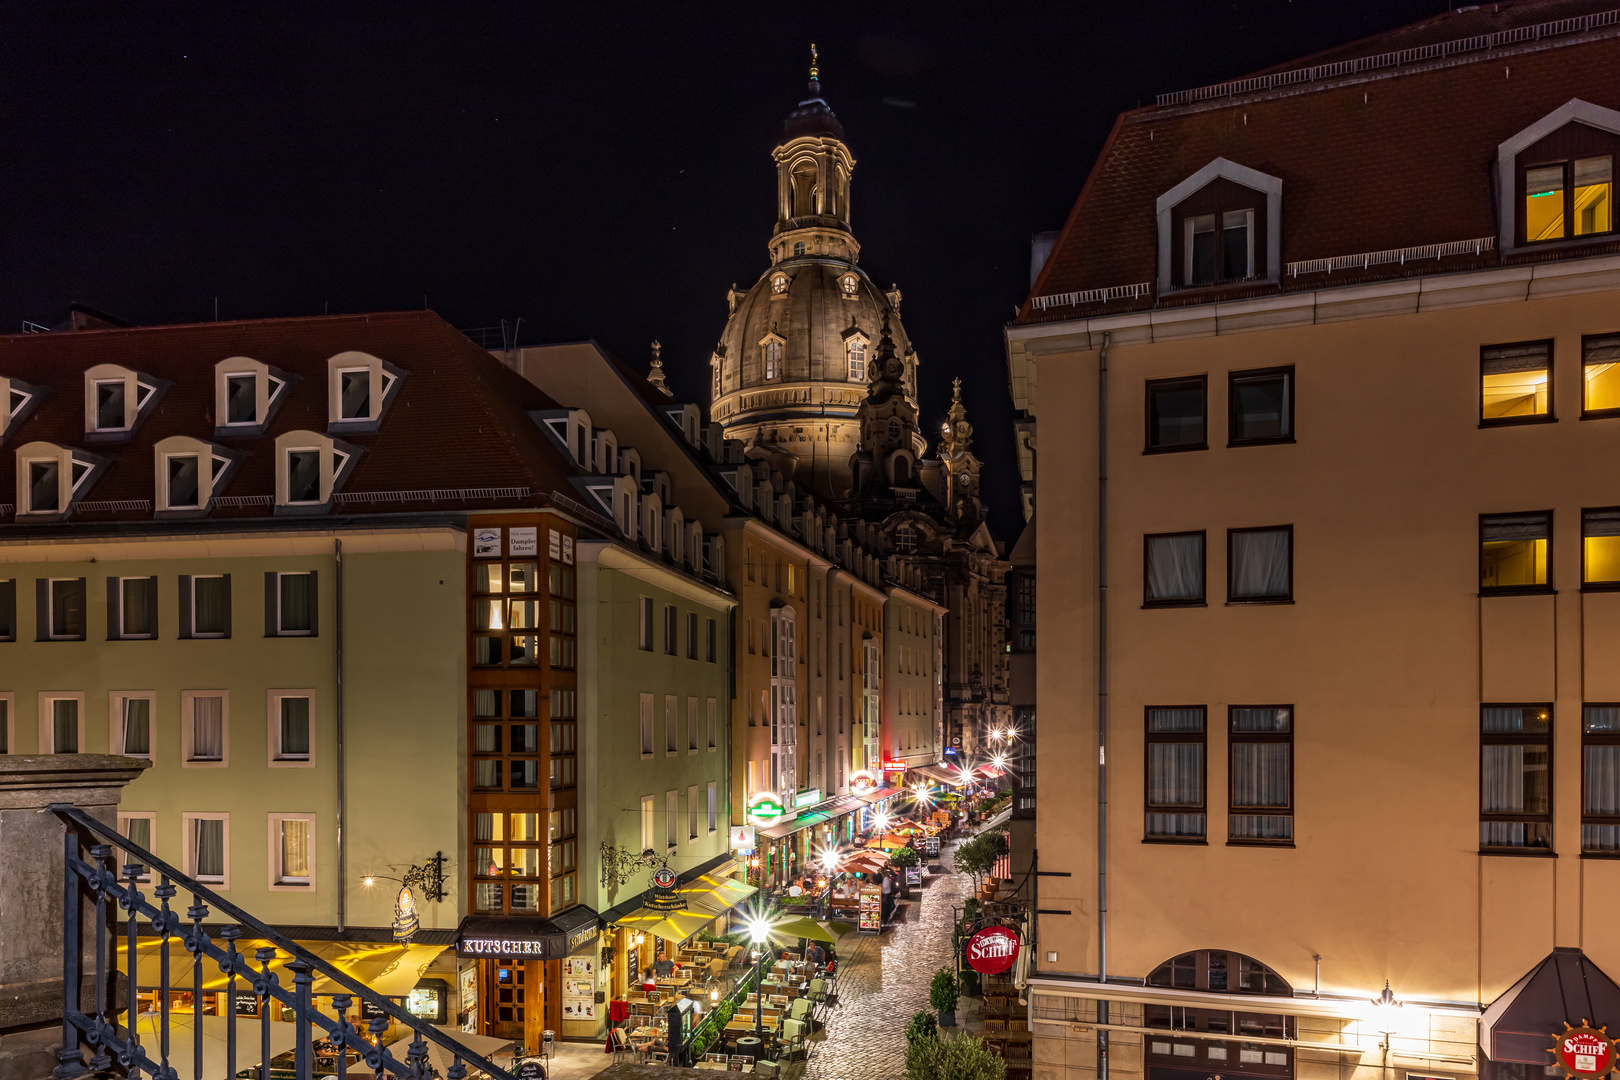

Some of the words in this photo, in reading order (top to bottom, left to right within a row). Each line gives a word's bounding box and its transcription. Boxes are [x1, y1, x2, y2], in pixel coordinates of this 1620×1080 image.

[463, 939, 542, 954] KUTSCHER
[980, 936, 1008, 947] DAM
[1573, 1034, 1598, 1042] DAMPF
[1564, 1039, 1607, 1055] SCHIFF
